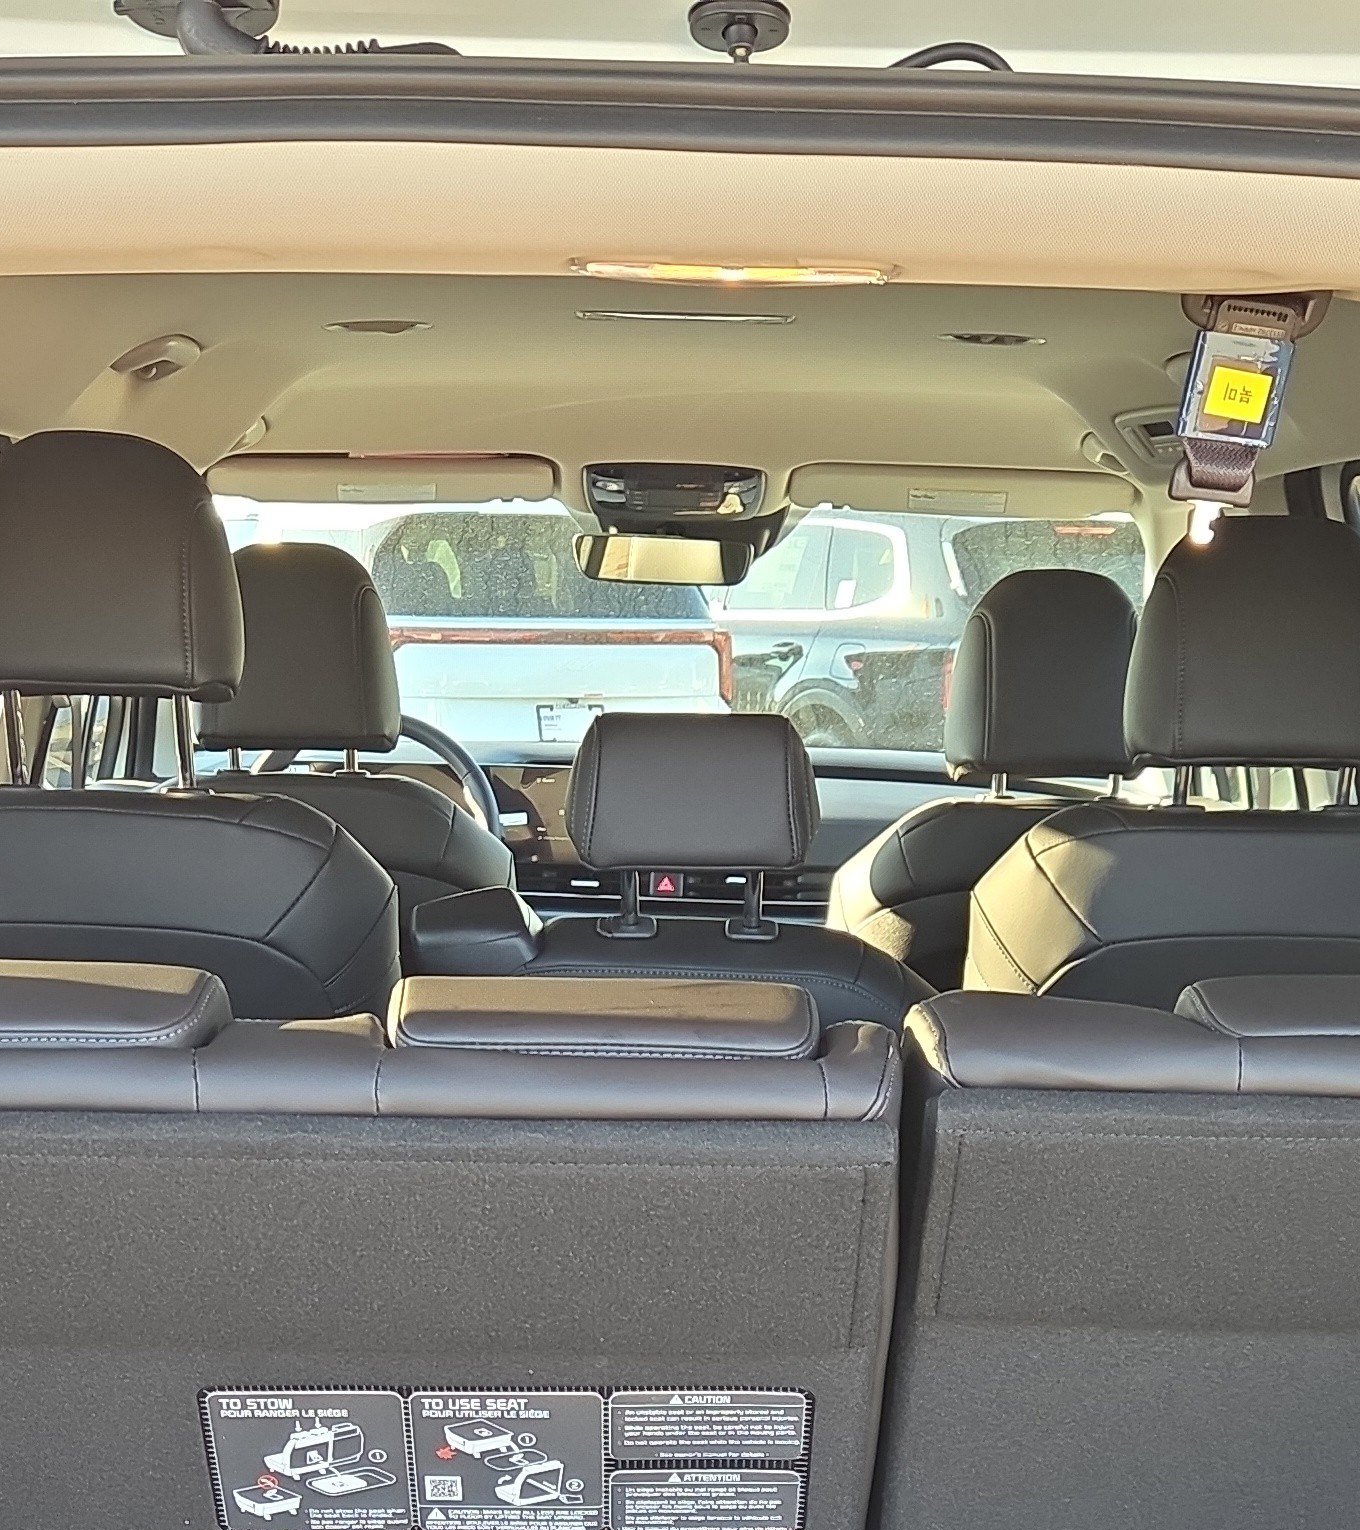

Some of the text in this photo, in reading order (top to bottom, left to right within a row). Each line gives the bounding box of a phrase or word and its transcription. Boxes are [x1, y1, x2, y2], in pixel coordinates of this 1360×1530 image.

[218, 1398, 293, 1410] TO STOW
[420, 1398, 529, 1410] TO USE SEAT
[684, 1396, 731, 1404] CAUTION
[220, 1410, 252, 1418] POUR
[254, 1410, 300, 1418] RANGER
[301, 1410, 315, 1418] LE
[422, 1410, 454, 1418] POUR
[455, 1410, 501, 1418] UTILISER
[503, 1410, 517, 1418] LE
[683, 1474, 740, 1482] ATTENTION
